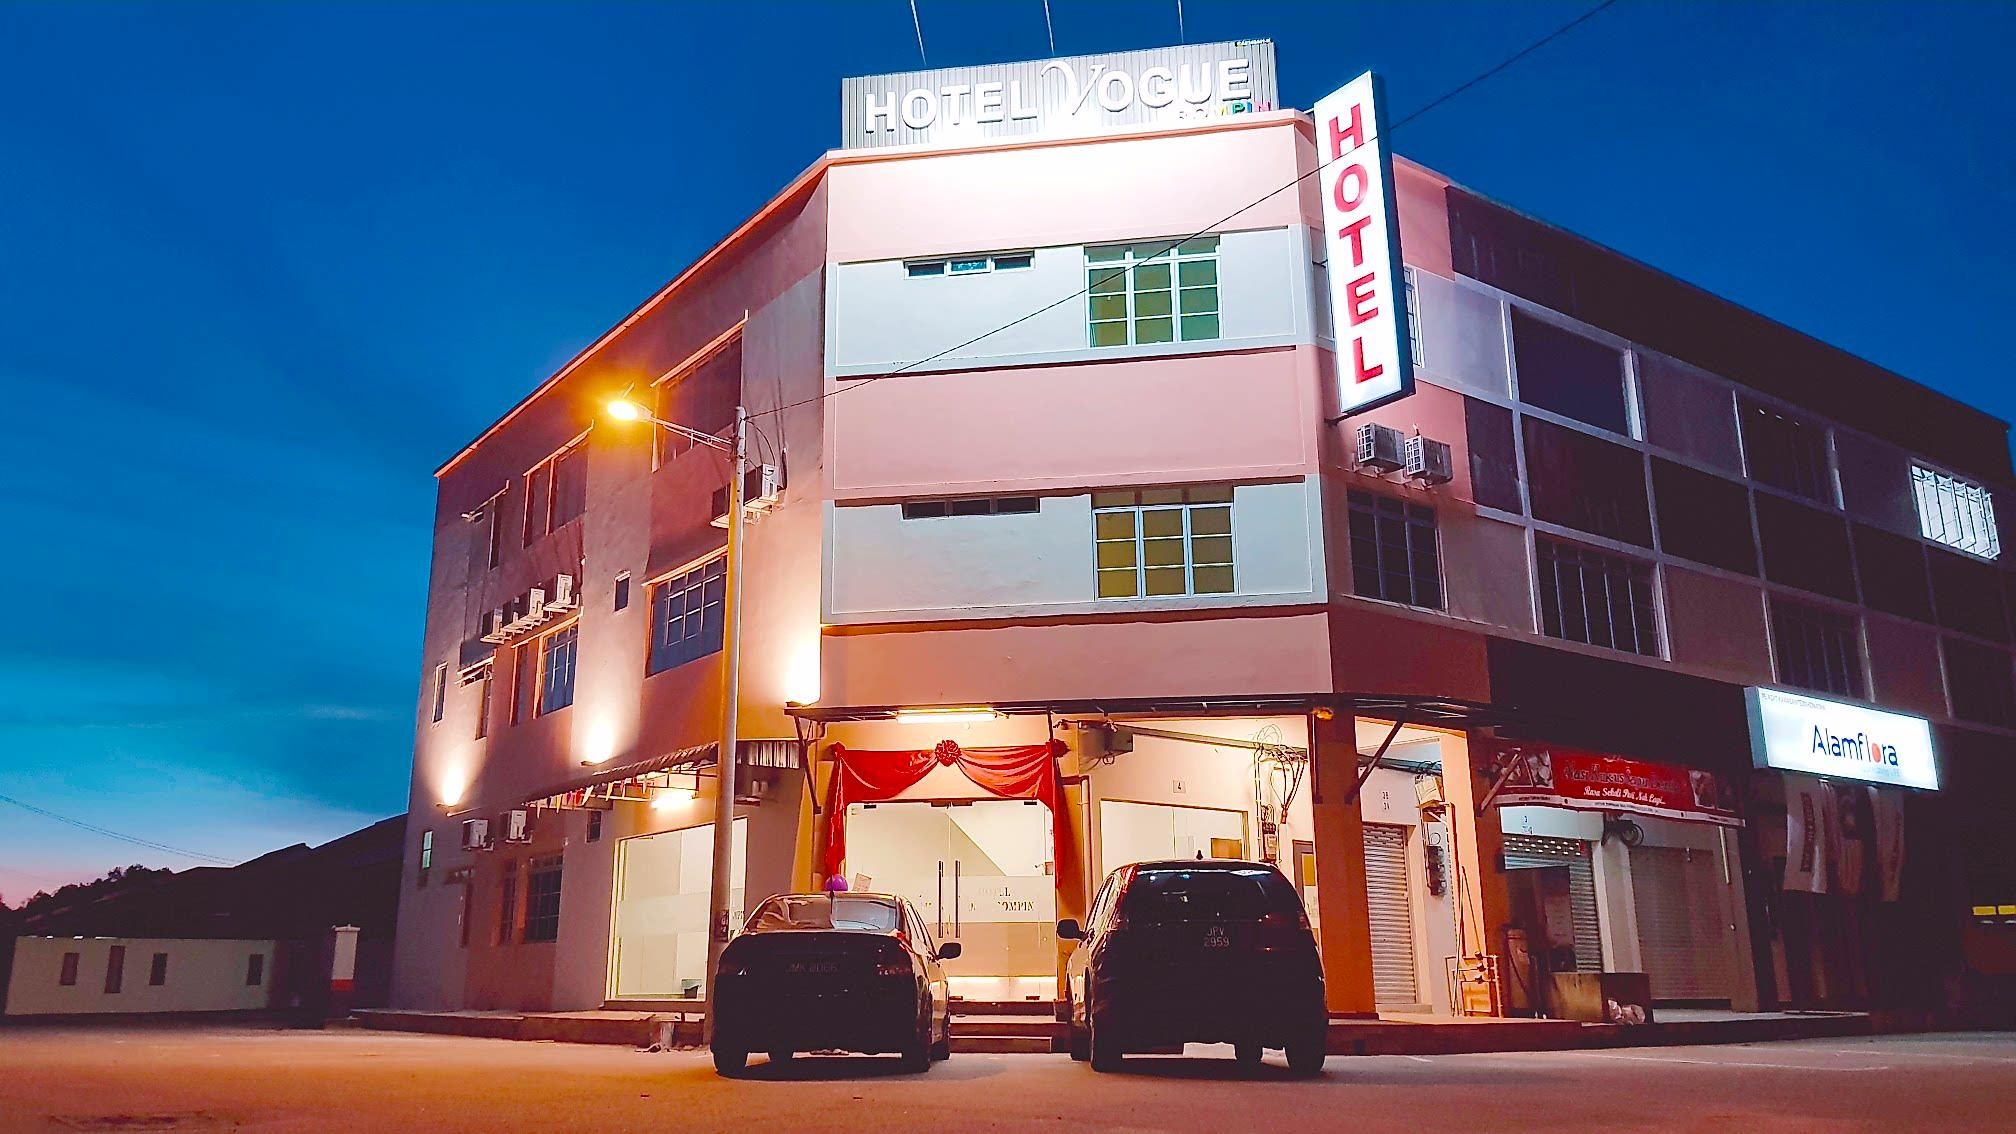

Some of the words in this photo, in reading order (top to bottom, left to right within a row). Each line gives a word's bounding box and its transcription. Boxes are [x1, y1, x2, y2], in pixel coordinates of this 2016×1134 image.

[865, 80, 1038, 134] HOTEL
[1041, 59, 1252, 116] VOGUE
[1328, 103, 1384, 384] HOTEL
[1812, 724, 1899, 767] Alamflora
[997, 901, 1034, 912] OMPIN
